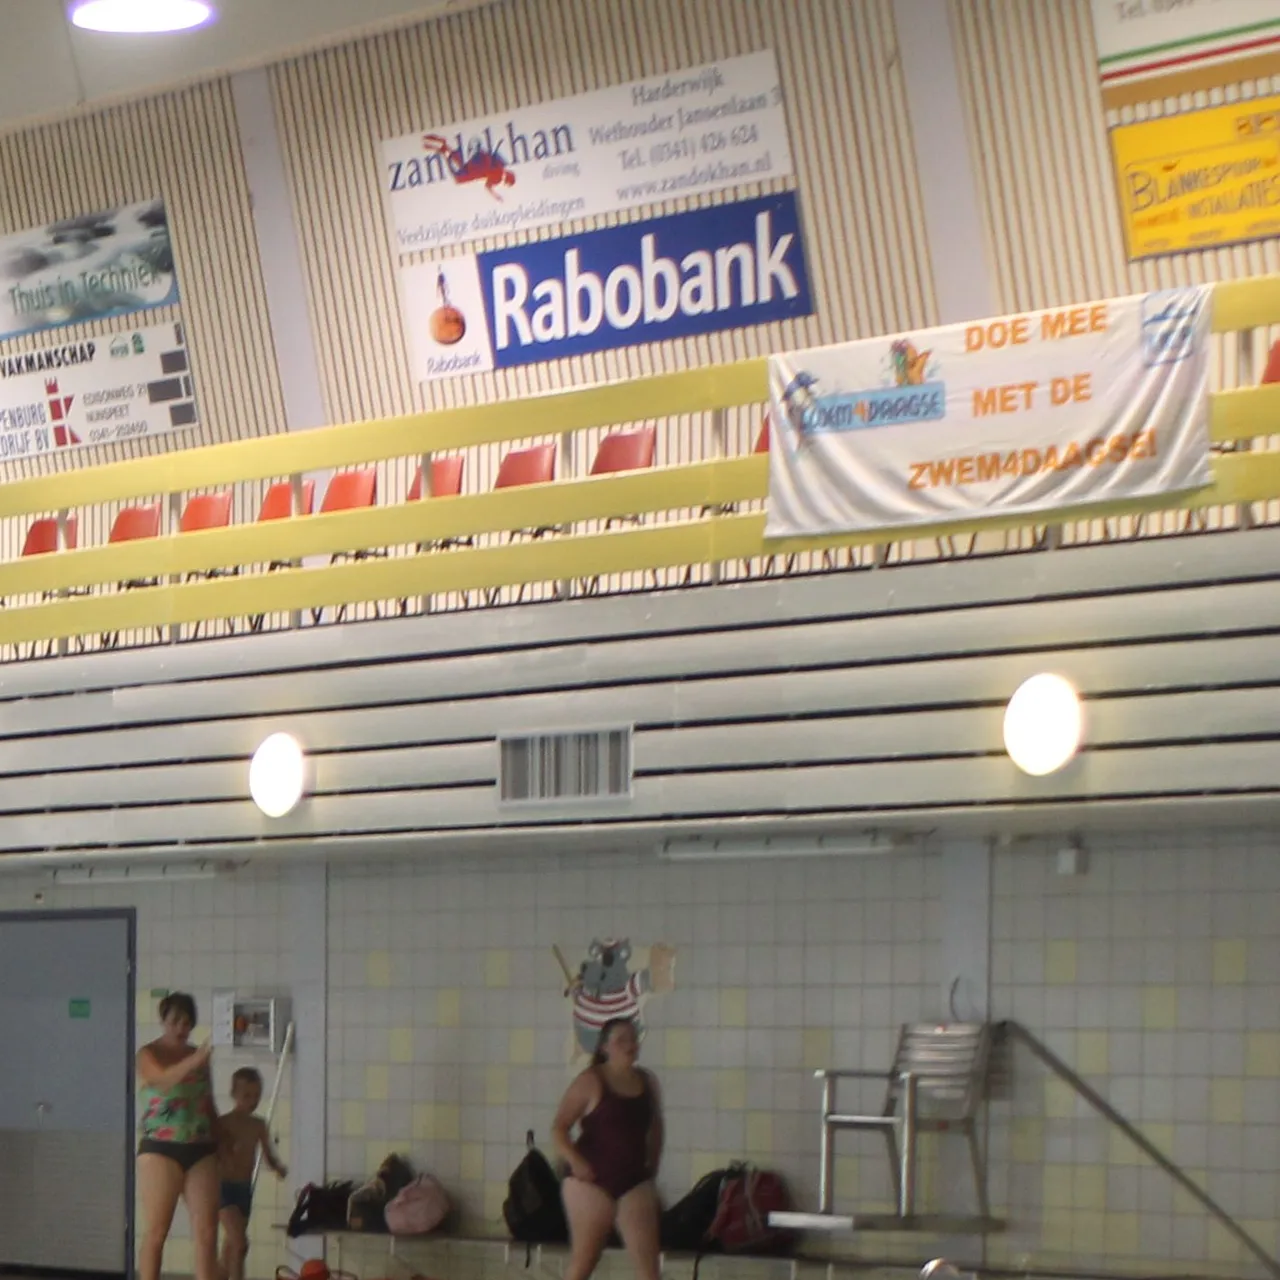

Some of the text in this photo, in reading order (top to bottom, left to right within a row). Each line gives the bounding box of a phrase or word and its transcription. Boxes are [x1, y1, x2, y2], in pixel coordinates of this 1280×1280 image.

[7, 256, 164, 317] Thuis in Techniek
[491, 210, 799, 352] Rabobank
[965, 303, 1109, 354] DOE MEE
[426, 349, 482, 375] Rabobank
[971, 372, 1092, 418] MET DE
[34, 427, 50, 452] BV
